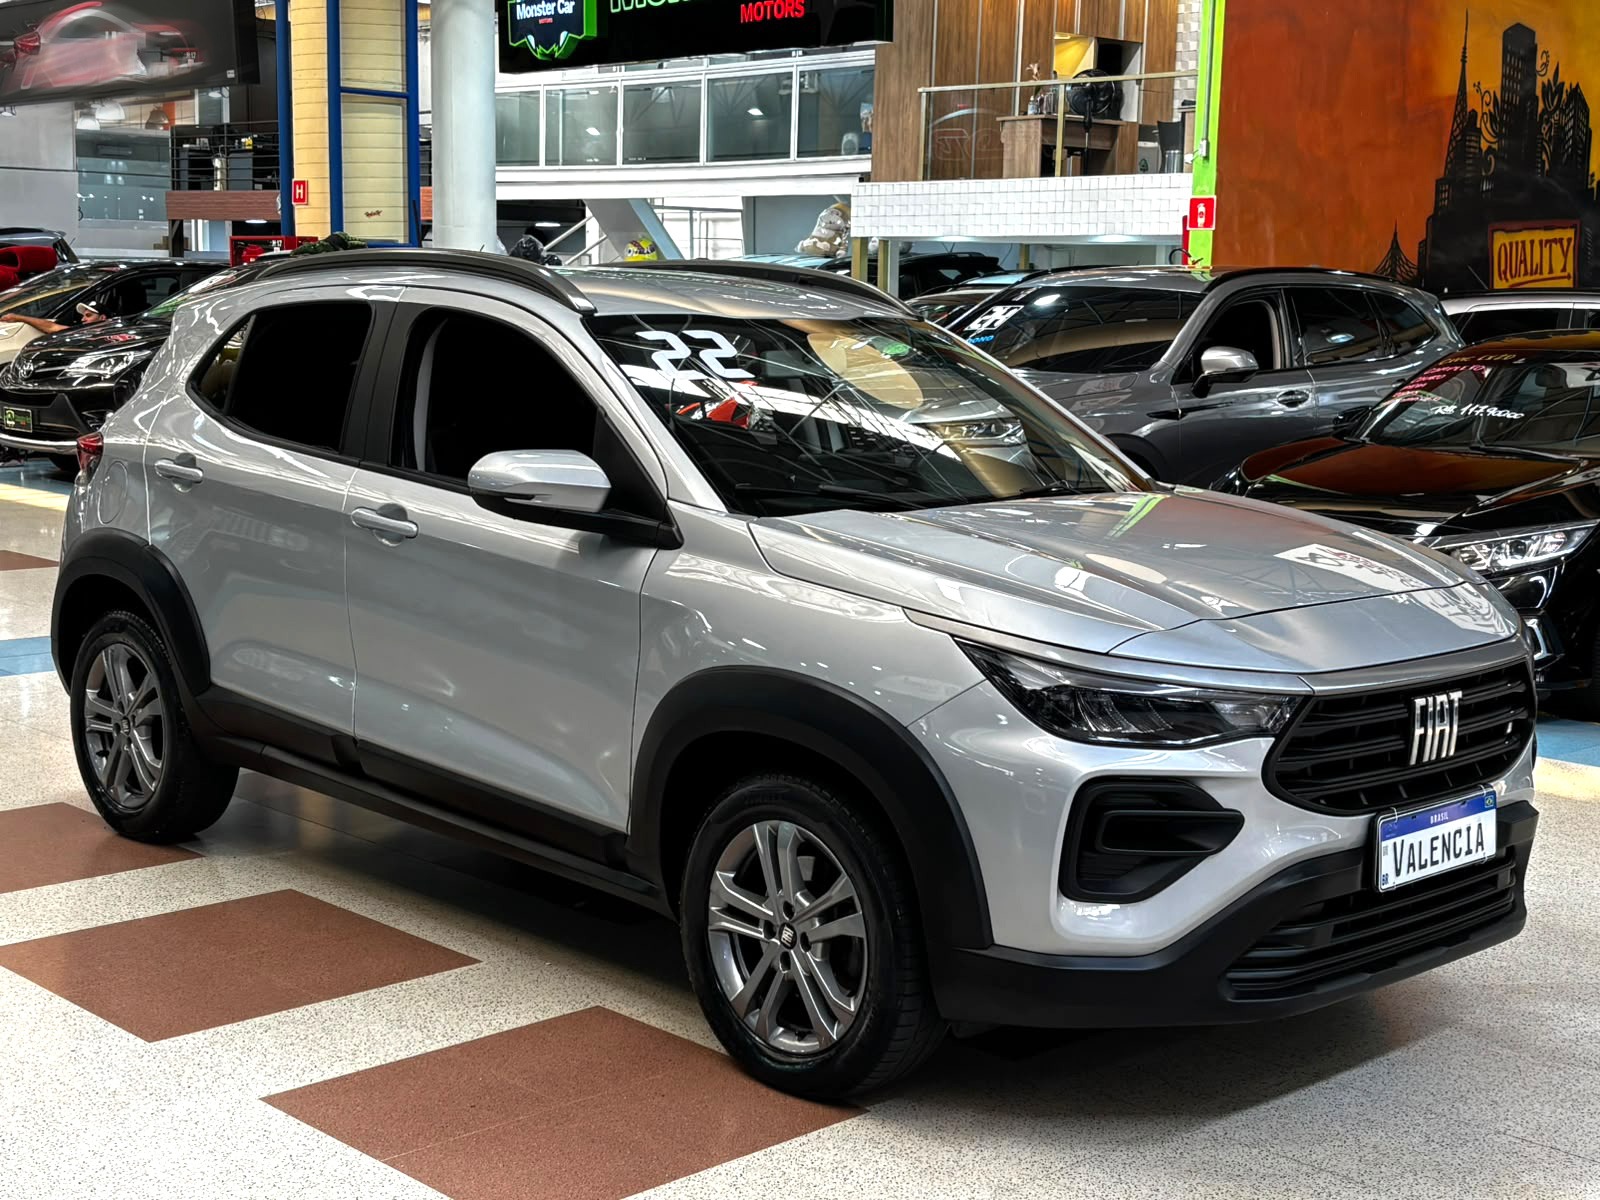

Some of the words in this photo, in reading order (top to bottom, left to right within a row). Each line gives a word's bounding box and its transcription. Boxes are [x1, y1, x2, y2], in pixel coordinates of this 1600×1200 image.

[516, 3, 555, 20] Monster
[557, 0, 575, 14] Car
[740, 0, 805, 23] MOTORS
[295, 184, 304, 199] H
[1497, 237, 1572, 283] QUALITY
[635, 329, 755, 380] 22
[1409, 690, 1463, 766] FIAT
[1430, 810, 1450, 825] BRASIL
[1393, 822, 1485, 878] VALENCIA
